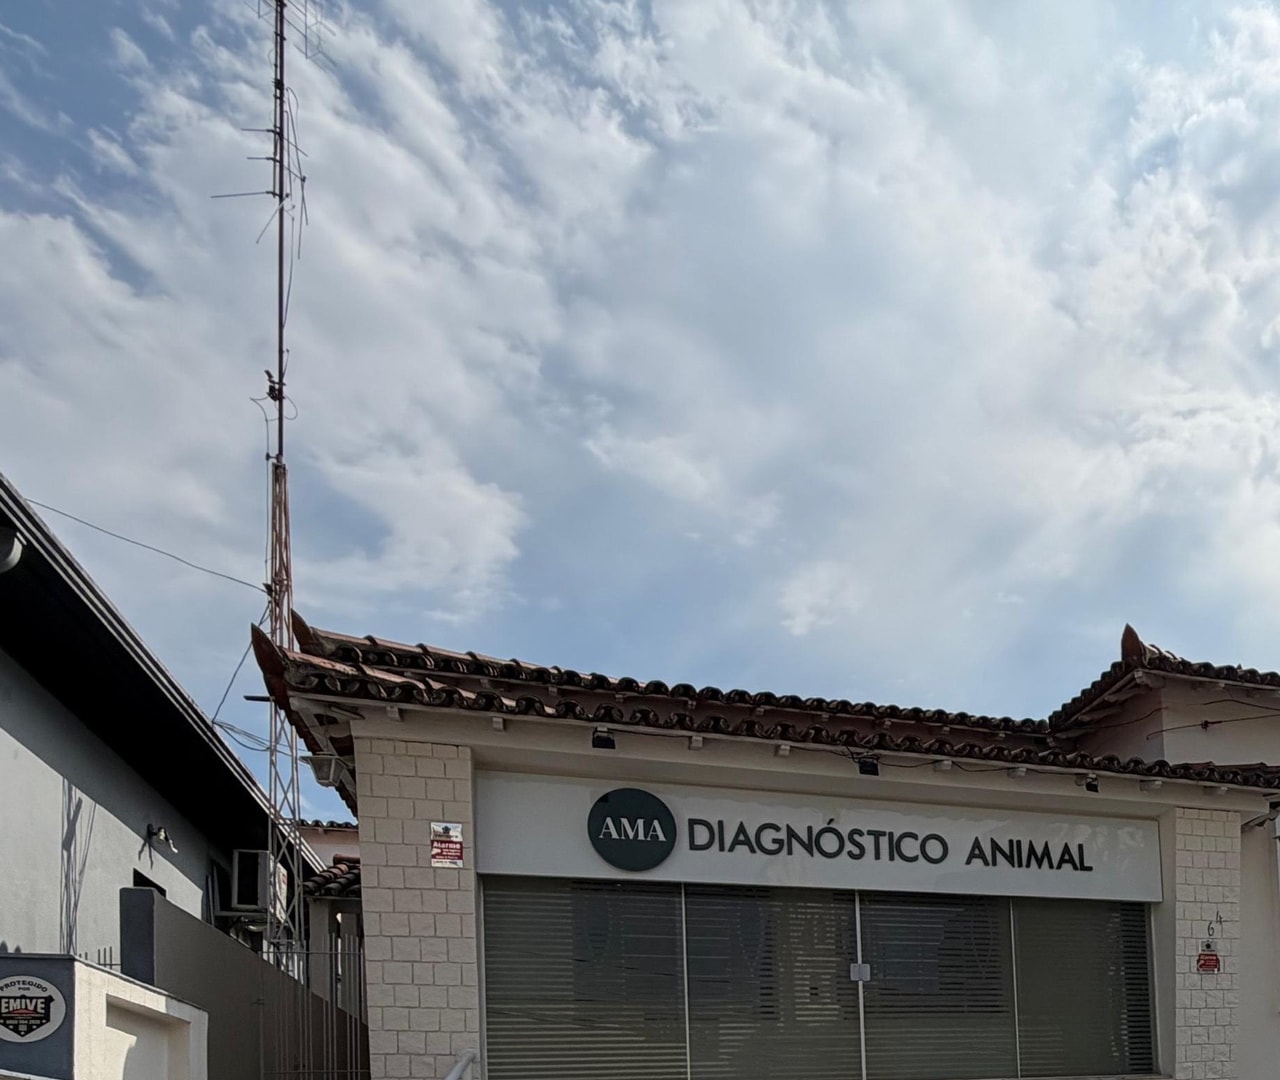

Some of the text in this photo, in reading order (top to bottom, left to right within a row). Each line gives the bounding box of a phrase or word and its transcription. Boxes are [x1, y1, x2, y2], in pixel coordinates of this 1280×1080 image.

[599, 816, 668, 842] AMA
[687, 817, 1094, 872] DIAGNÓSTICO ANIMAL
[0, 980, 48, 992] PROTEGIDO
[0, 998, 46, 1014] EMIVE
